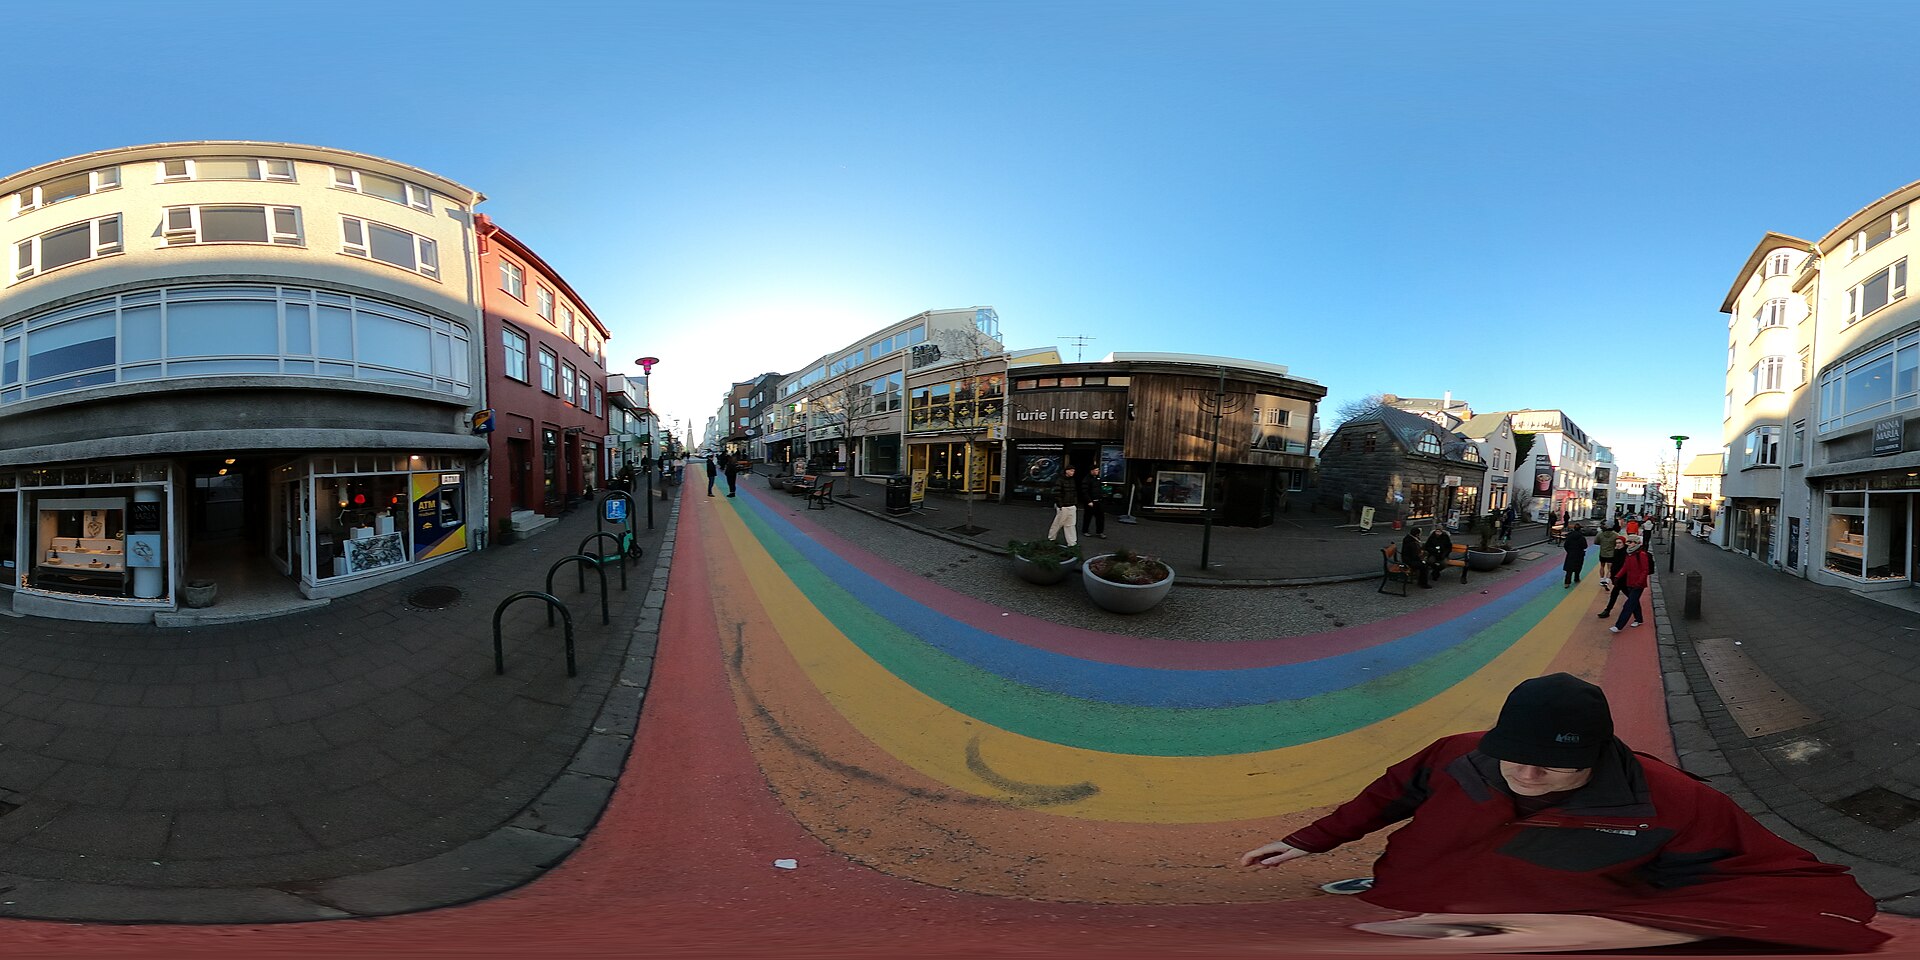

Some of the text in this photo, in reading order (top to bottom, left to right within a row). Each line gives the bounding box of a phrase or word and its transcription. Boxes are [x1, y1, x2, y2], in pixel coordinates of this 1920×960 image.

[1016, 409, 1048, 421] iurie
[1059, 408, 1088, 420] fine
[1092, 409, 1115, 420] art
[1876, 420, 1900, 432] ANNA
[418, 499, 436, 510] ATM
[612, 501, 620, 510] P
